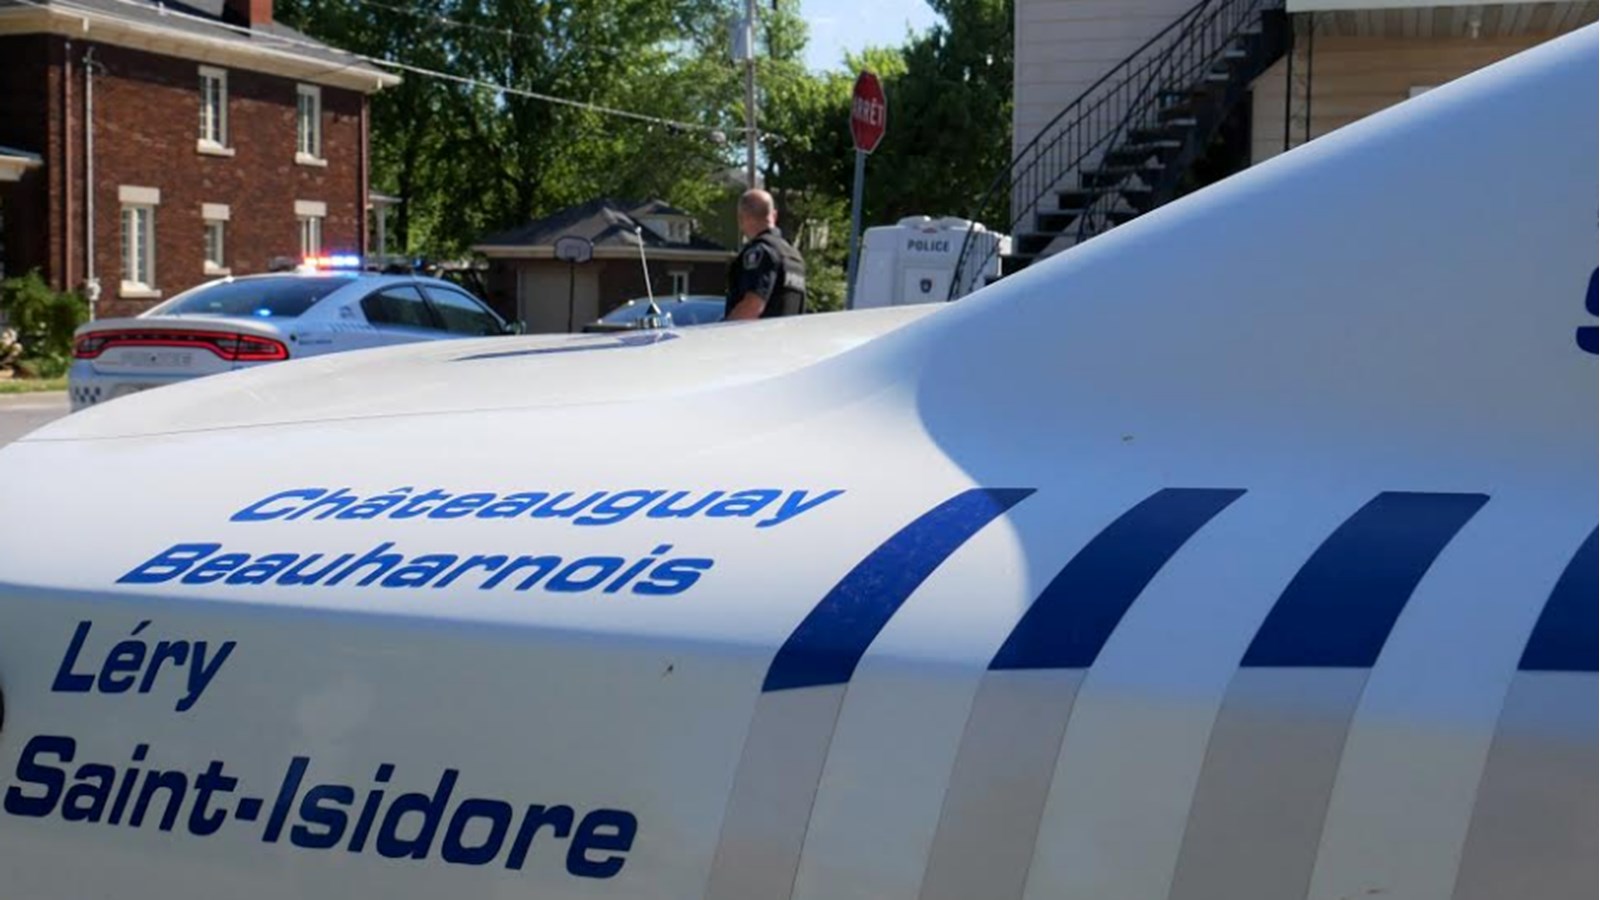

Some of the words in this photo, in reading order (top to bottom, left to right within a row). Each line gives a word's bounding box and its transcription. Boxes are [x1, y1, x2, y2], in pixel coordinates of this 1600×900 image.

[907, 240, 950, 252] POLICE
[229, 486, 845, 528] Châteauguay
[115, 542, 714, 596] Beauharnois
[51, 620, 237, 712] Léry
[3, 734, 638, 879] Saint-Isidore
